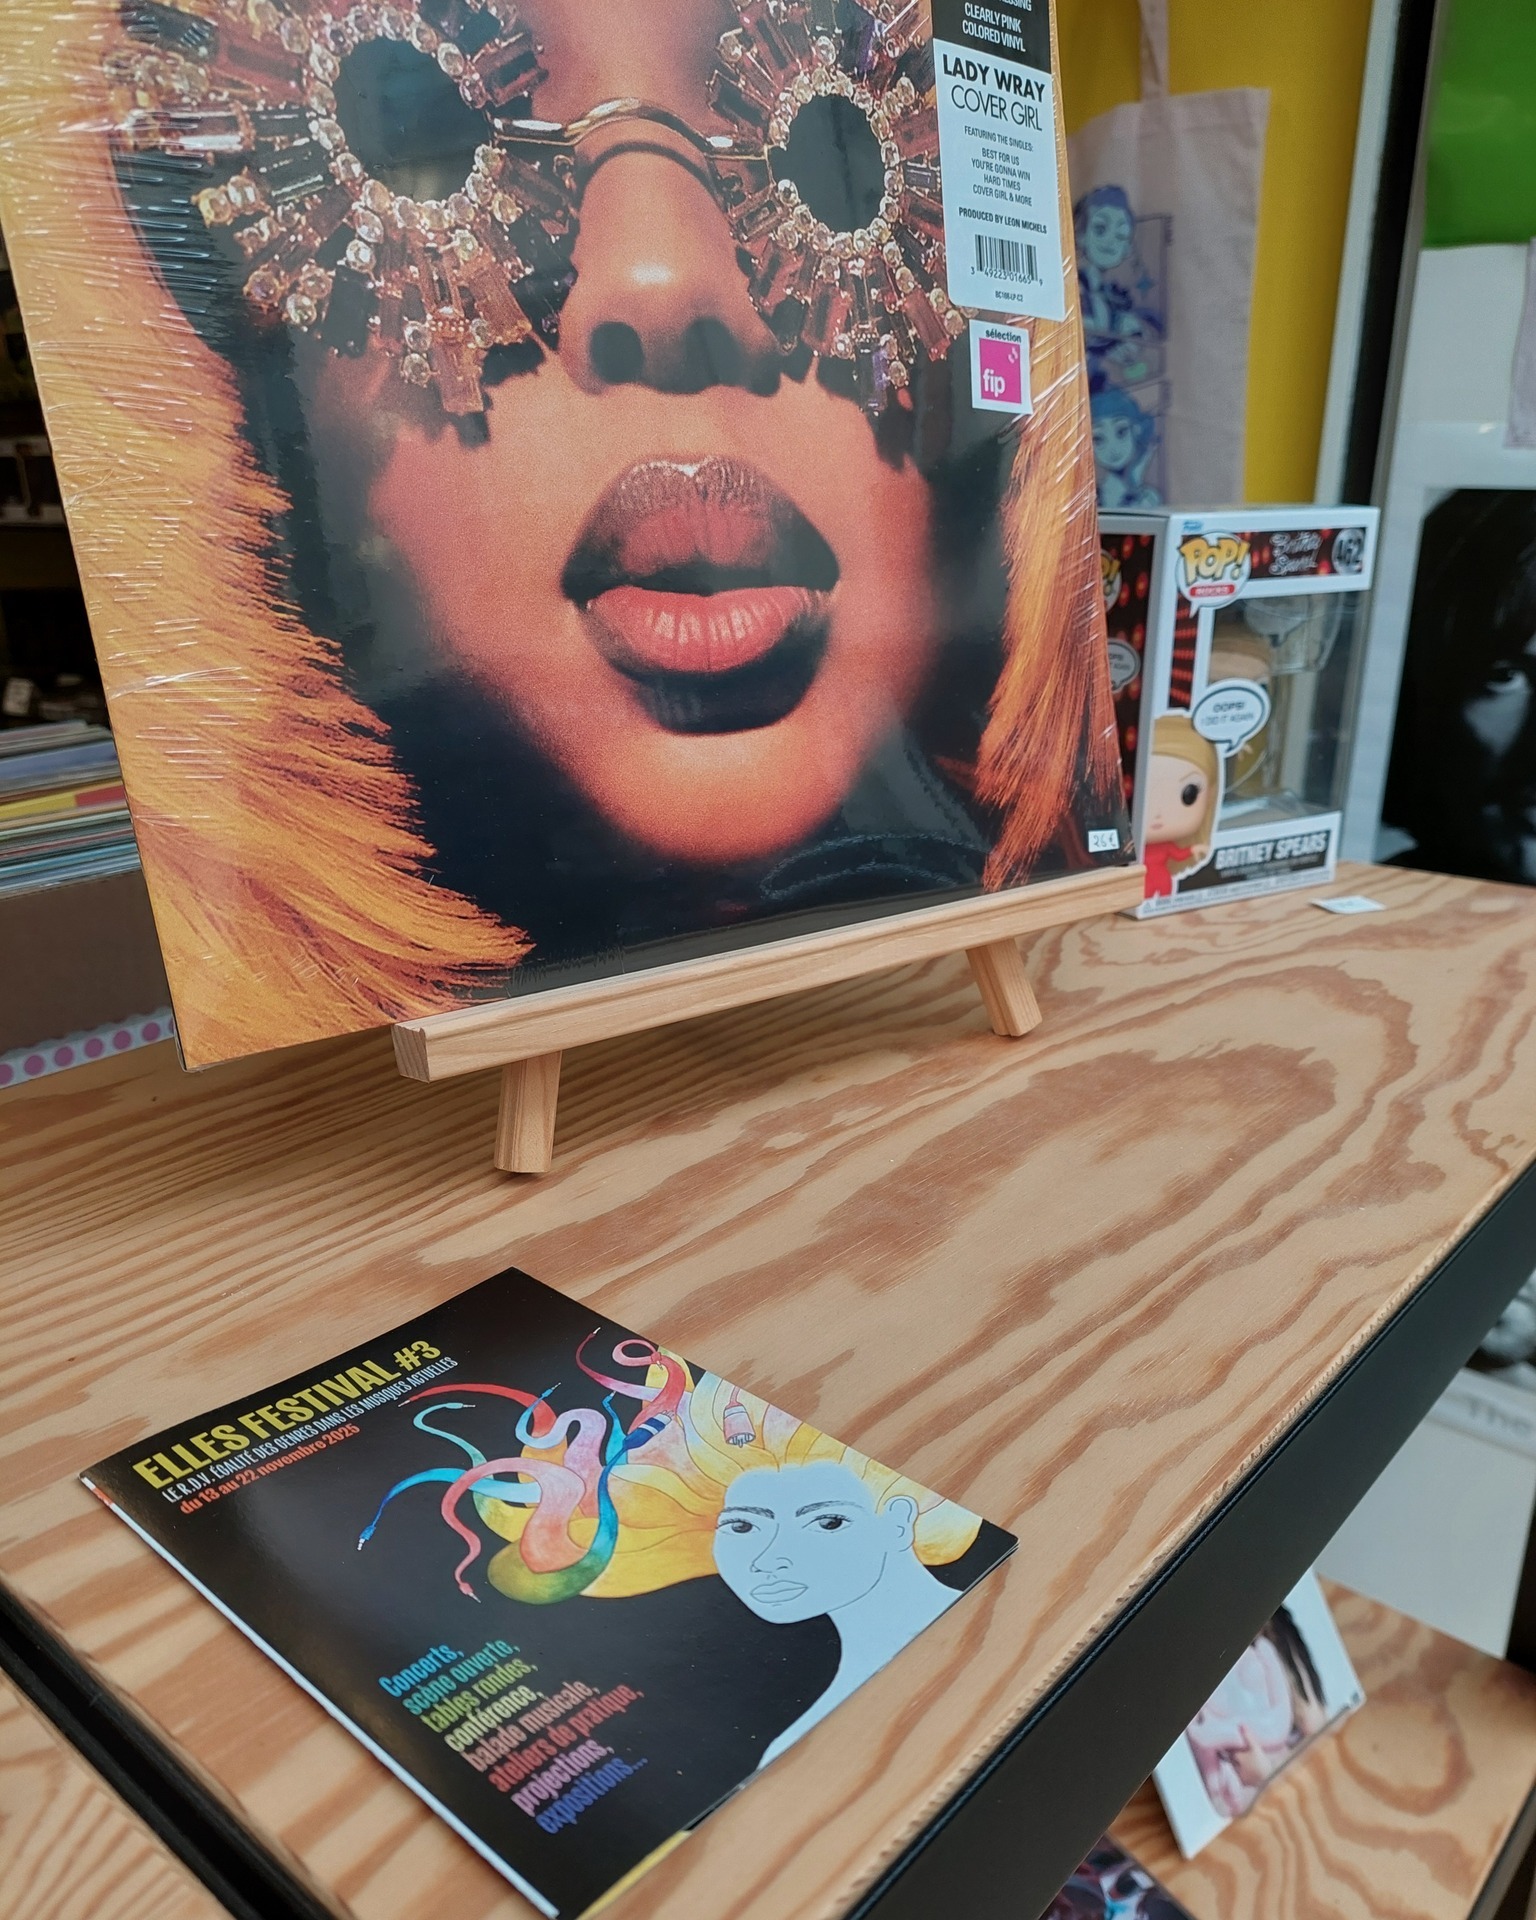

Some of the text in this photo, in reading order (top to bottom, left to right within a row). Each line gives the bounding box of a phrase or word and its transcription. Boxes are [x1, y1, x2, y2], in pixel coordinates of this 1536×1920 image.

[962, 20, 1026, 52] COLORED VINYL
[964, 2, 1022, 33] CLEARLY PINK
[943, 53, 1045, 103] LADY WRAY
[951, 84, 1043, 131] COVER GIRL
[964, 125, 1034, 152] FEATURING THE SINGLES:
[982, 147, 1020, 166] BEST FOR US
[971, 158, 1031, 181] YOU'RE GONNA WIN
[984, 173, 1021, 191] HARD TIMES
[973, 184, 1032, 207] COVER GIRL & MORE
[958, 207, 1047, 234] PRODUCED BY LEON MICHELS
[985, 329, 1022, 343] sélection
[983, 368, 1006, 397] fip
[1179, 537, 1251, 586] POP!
[1215, 842, 1275, 870] BRITNEY
[1274, 832, 1326, 859] SPEARS
[132, 1340, 441, 1489] ELLES FESTIVAL #3
[161, 1356, 459, 1504] LE R.D.V. ÉGALITÉ DES GENRES DANS LES MUSIQUES ACTUELLES
[180, 1423, 361, 1515] du 13 au 22 novembre 2025
[378, 1644, 464, 1698] Concerts,
[402, 1639, 520, 1716] scène ouverte,
[420, 1658, 538, 1733] tables rondes,
[443, 1684, 545, 1752] conférence,
[460, 1681, 600, 1773] balade musicale,
[488, 1684, 645, 1793] ateliers de pratique,
[510, 1739, 615, 1818] projections,
[535, 1757, 648, 1834] expositions...
